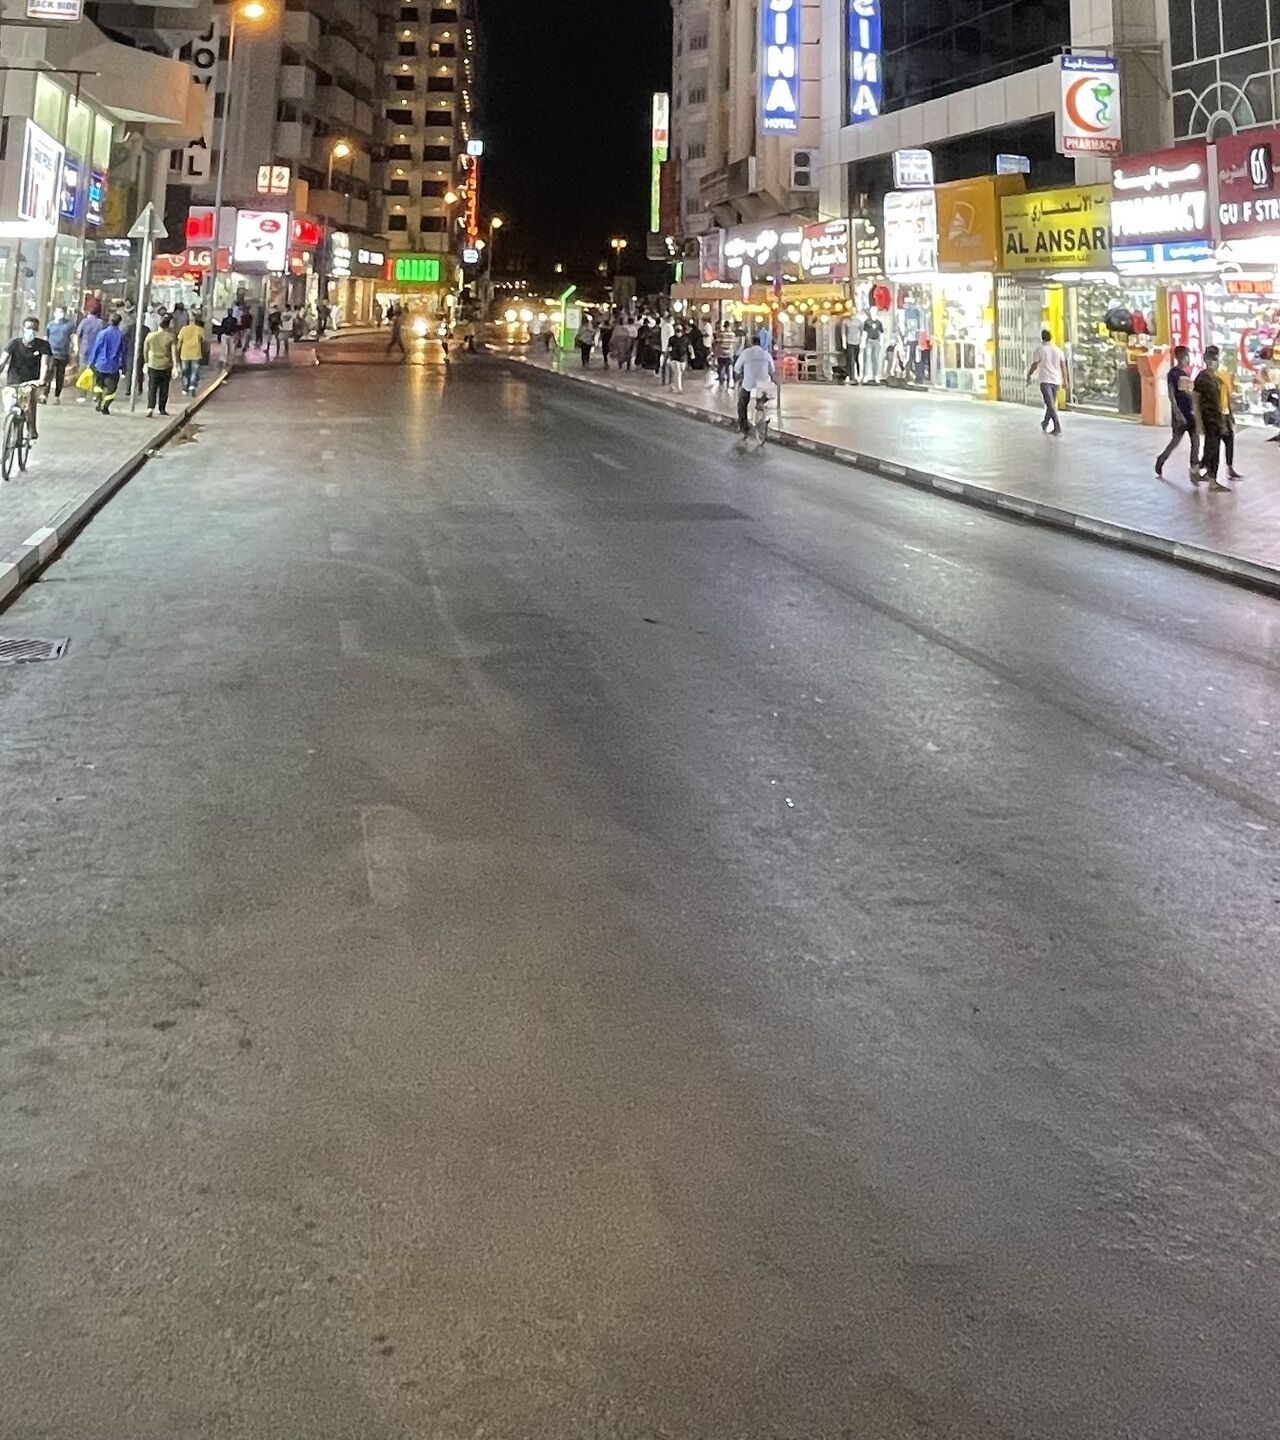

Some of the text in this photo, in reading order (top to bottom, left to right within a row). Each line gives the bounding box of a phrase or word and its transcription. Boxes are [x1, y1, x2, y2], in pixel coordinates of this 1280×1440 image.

[28, 0, 78, 11] BACK SIDE
[764, 118, 797, 129] HOTEL
[1065, 137, 1117, 151] PHARMACY
[1110, 190, 1207, 237] PHARMACY
[1006, 231, 1029, 255] AL
[1036, 226, 1112, 253] ANSARI
[189, 250, 211, 266] LG
